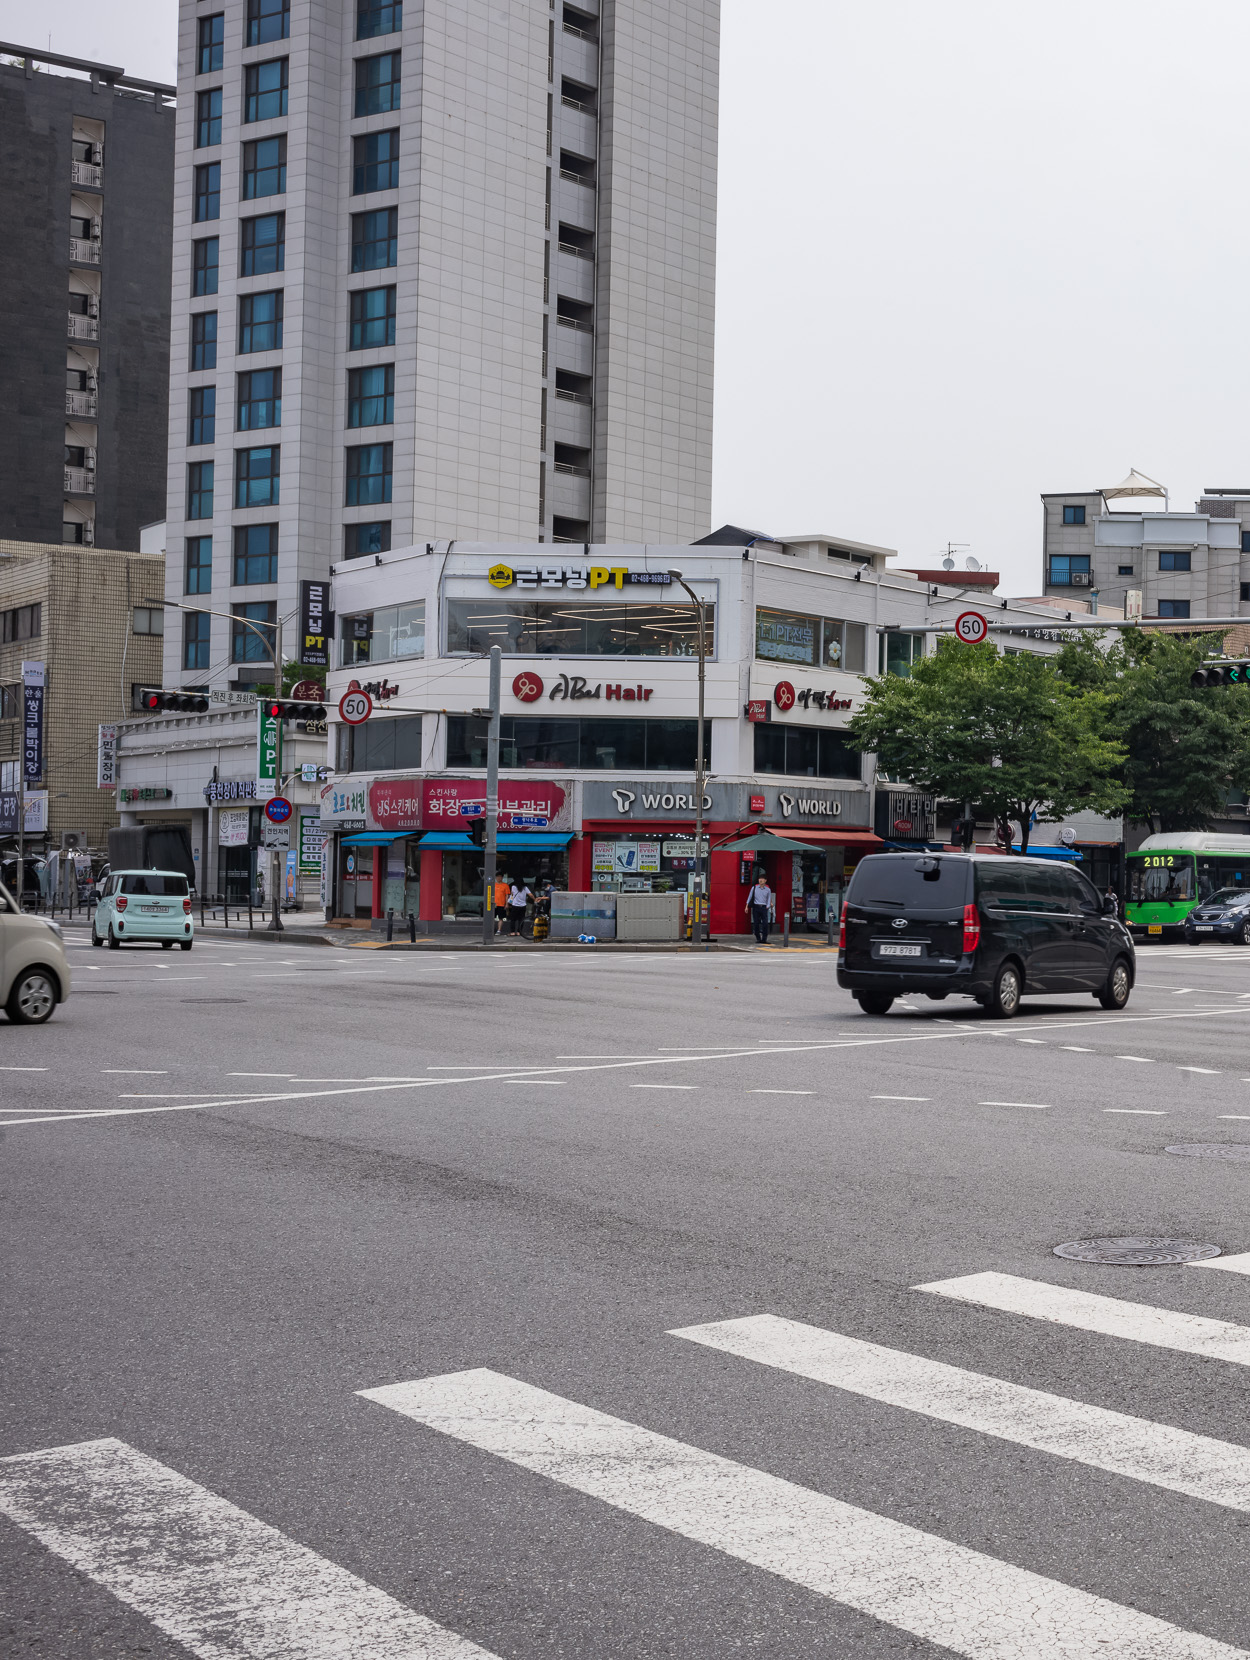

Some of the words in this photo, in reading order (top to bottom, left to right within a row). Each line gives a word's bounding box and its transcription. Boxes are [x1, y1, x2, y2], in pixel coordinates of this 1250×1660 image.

[962, 620, 981, 635] 50
[305, 635, 325, 649] PT
[213, 691, 226, 701] 직진
[228, 692, 234, 701] 후
[236, 693, 256, 704] 좌회전
[605, 683, 654, 701] Hair
[345, 699, 365, 715] 50
[428, 788, 458, 797] 스킨사랑
[0, 797, 16, 817] 공장
[797, 798, 842, 816] WORLD
[1144, 856, 1174, 867] 2012
[900, 946, 917, 954] 8781
